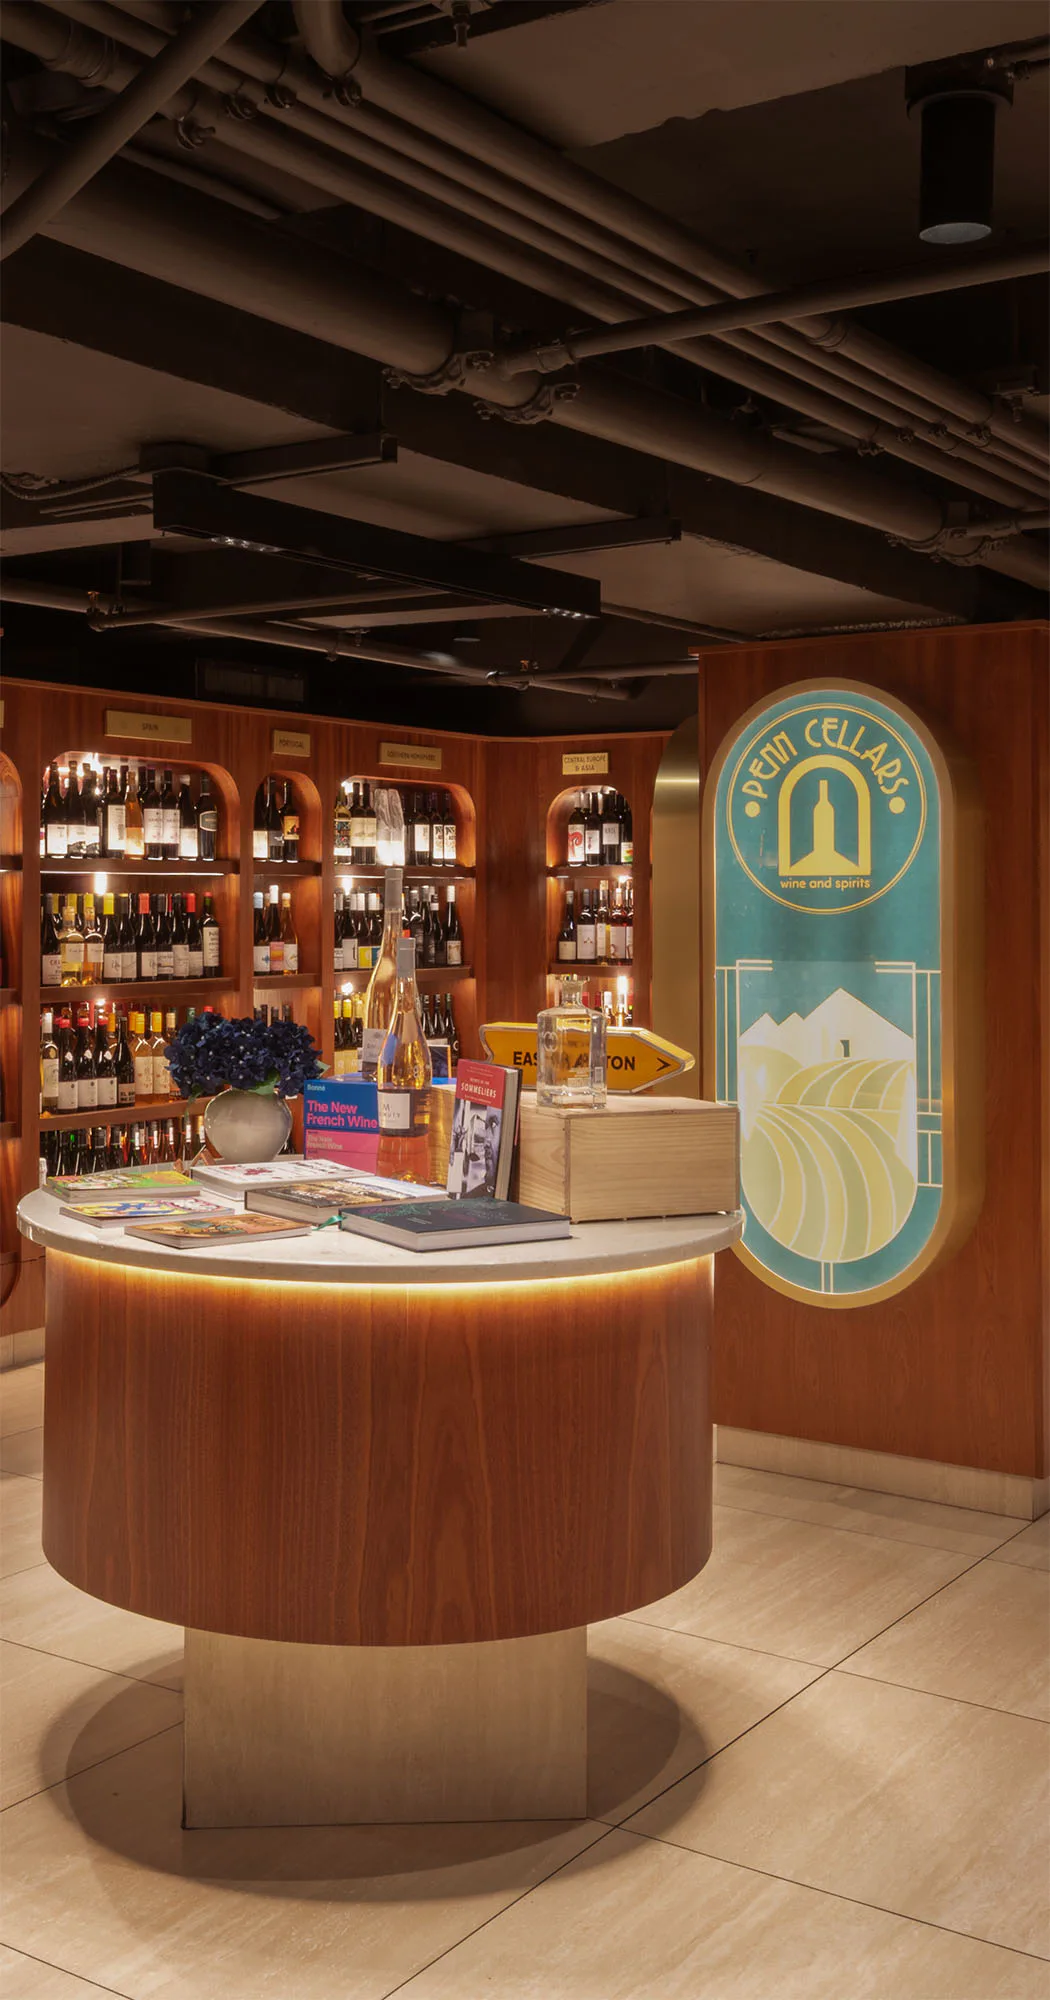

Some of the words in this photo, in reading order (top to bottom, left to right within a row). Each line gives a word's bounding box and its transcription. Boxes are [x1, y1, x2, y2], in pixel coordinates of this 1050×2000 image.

[586, 754, 607, 763] EUROPE
[741, 730, 799, 799] PENN
[804, 717, 909, 795] CELLARS
[780, 876, 806, 889] wine
[809, 876, 832, 889] and
[835, 876, 871, 892] spirits
[513, 1051, 539, 1067] EAS
[461, 1082, 498, 1099] SOMMELIERS
[307, 1099, 329, 1112] The
[331, 1100, 358, 1114] New
[306, 1113, 345, 1127] French
[347, 1115, 378, 1128] Wine
